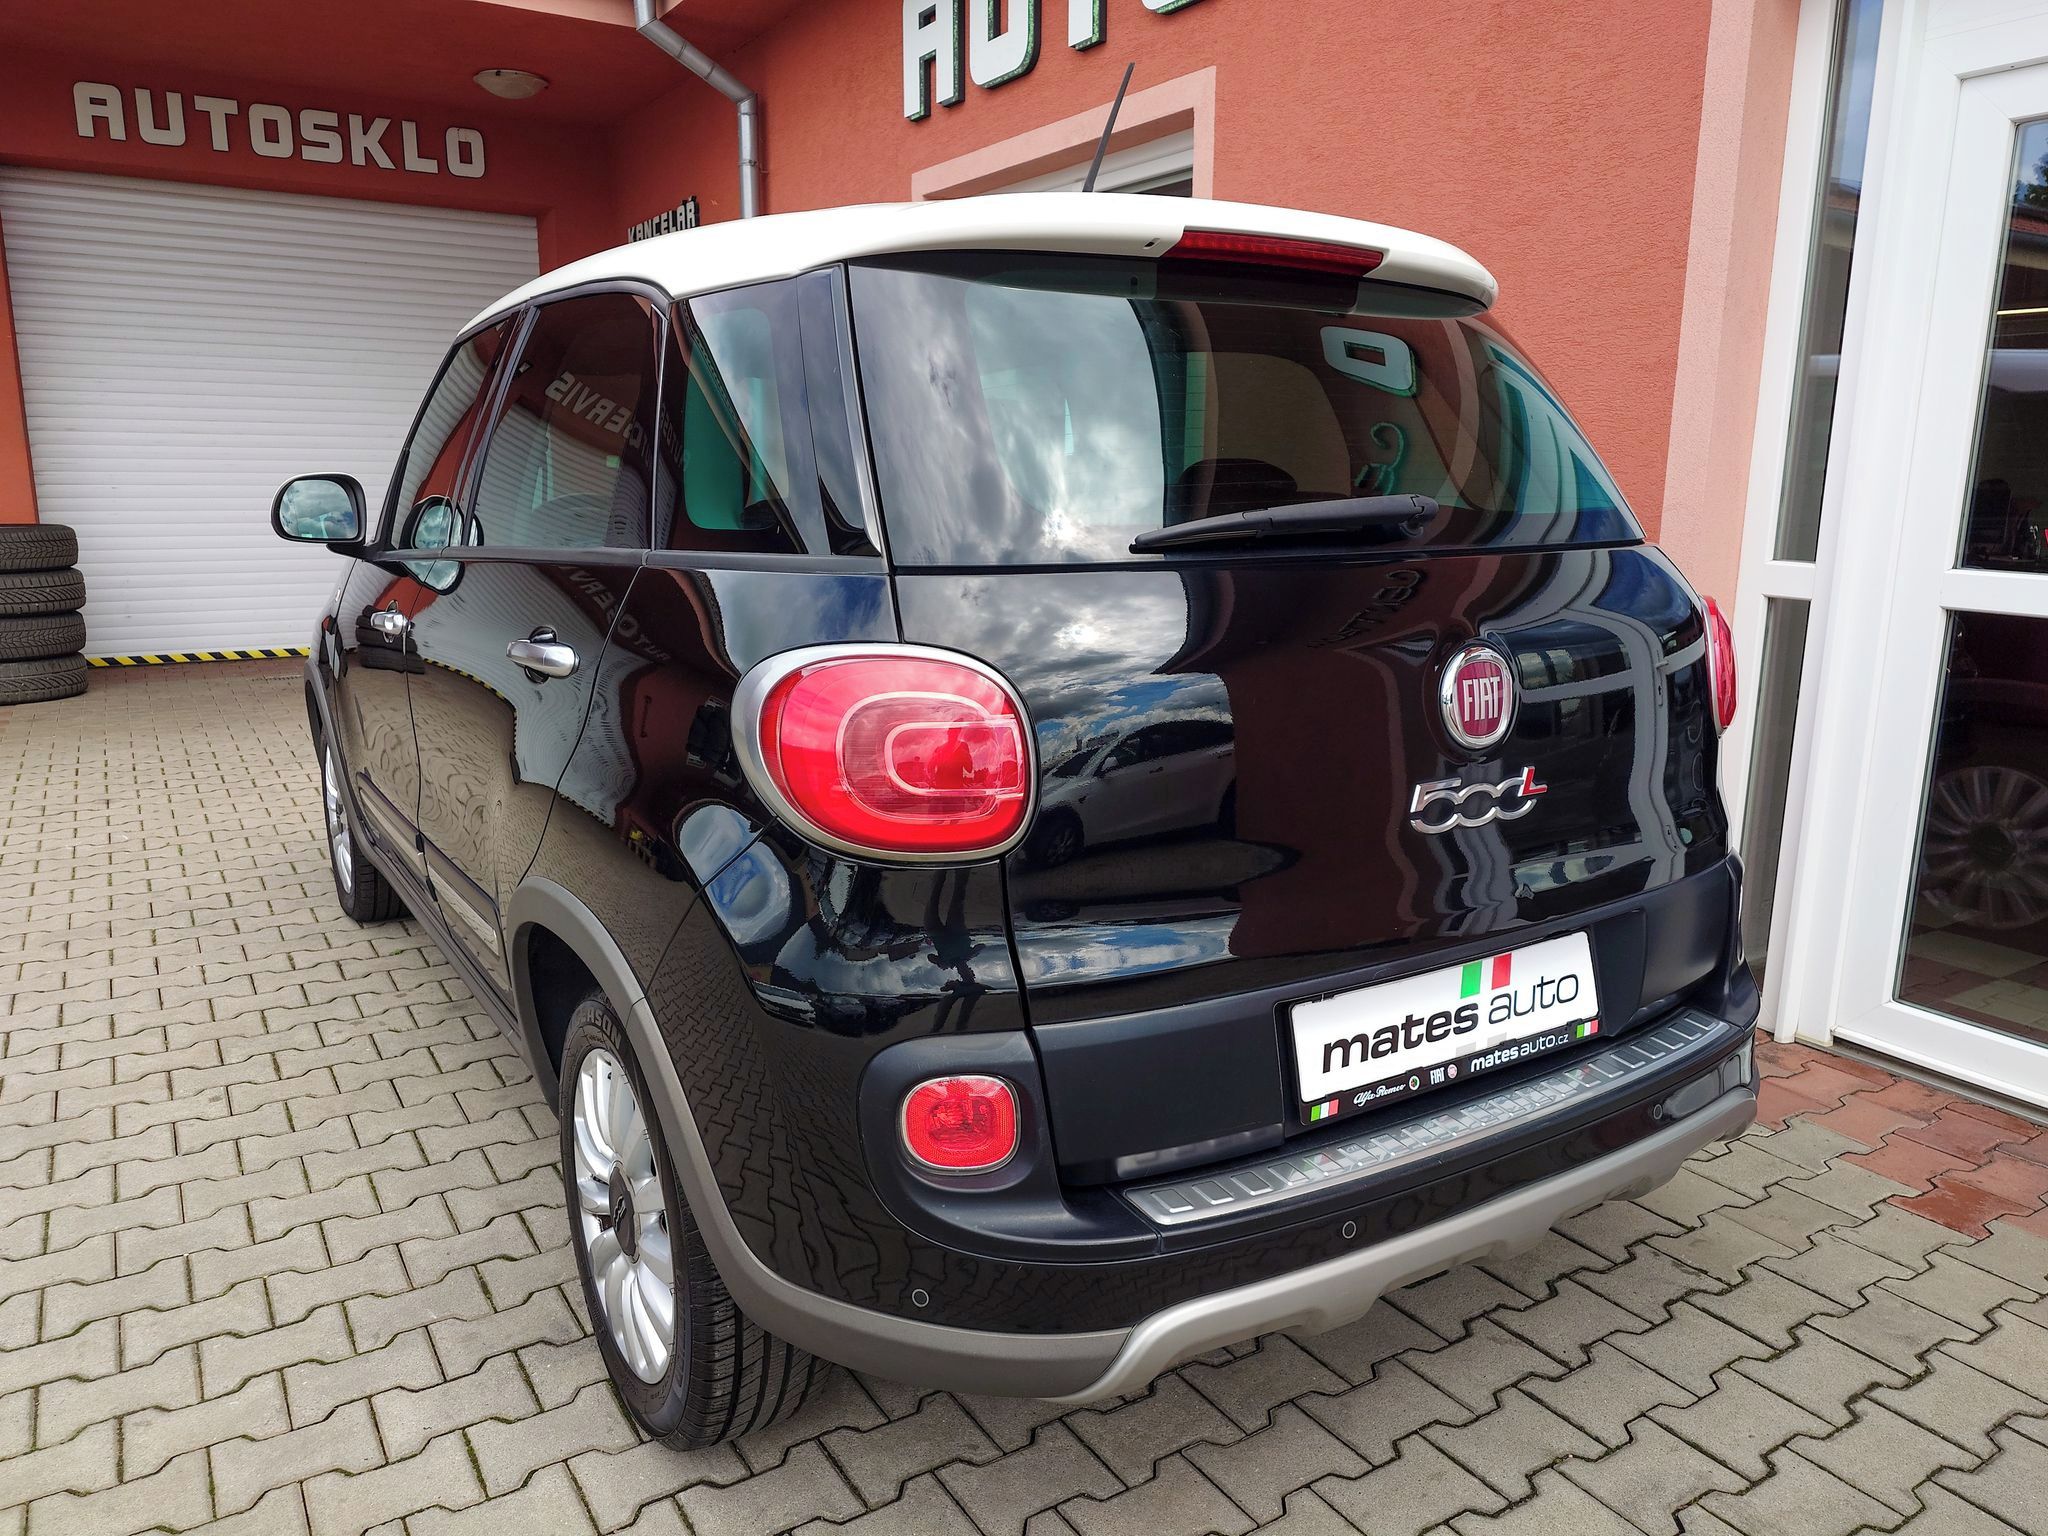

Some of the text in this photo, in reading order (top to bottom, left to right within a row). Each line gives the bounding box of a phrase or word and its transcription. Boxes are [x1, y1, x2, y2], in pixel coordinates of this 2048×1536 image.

[72, 81, 486, 179] AUTOSKLO
[1462, 676, 1500, 722] FIAT
[1409, 765, 1548, 835] 500L
[1322, 974, 1579, 1074] mates auto
[1471, 1033, 1570, 1073] matesauto.cz
[1430, 1067, 1445, 1085] FIAT
